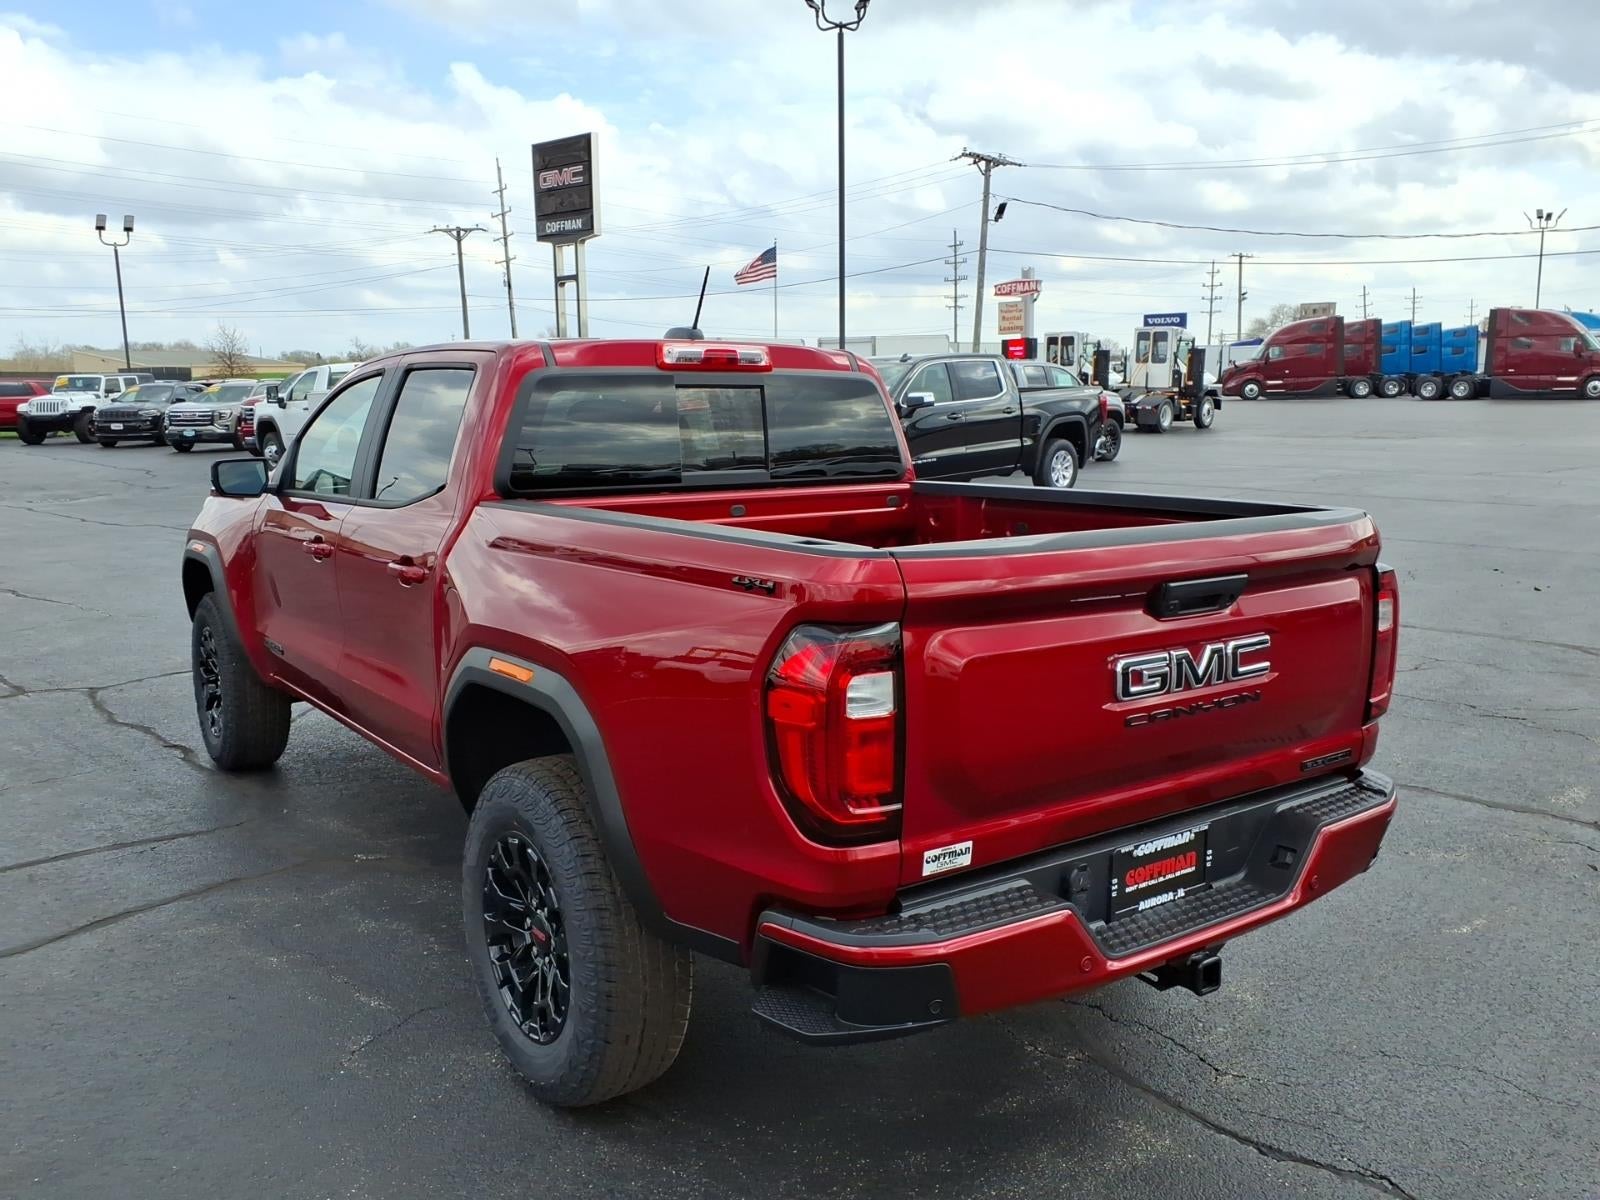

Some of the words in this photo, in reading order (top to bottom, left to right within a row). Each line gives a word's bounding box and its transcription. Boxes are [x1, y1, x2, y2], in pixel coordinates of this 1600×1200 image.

[540, 165, 583, 189] GMC
[545, 218, 582, 232] COFFMAN
[996, 281, 1036, 294] COFFMAN
[1146, 316, 1180, 325] VOLVO
[1115, 632, 1271, 702] GMC
[1124, 690, 1262, 728] CANYON
[925, 847, 970, 864] COFFMAN
[1136, 831, 1190, 856] COFFMAN
[1126, 851, 1196, 886] COFFMAN
